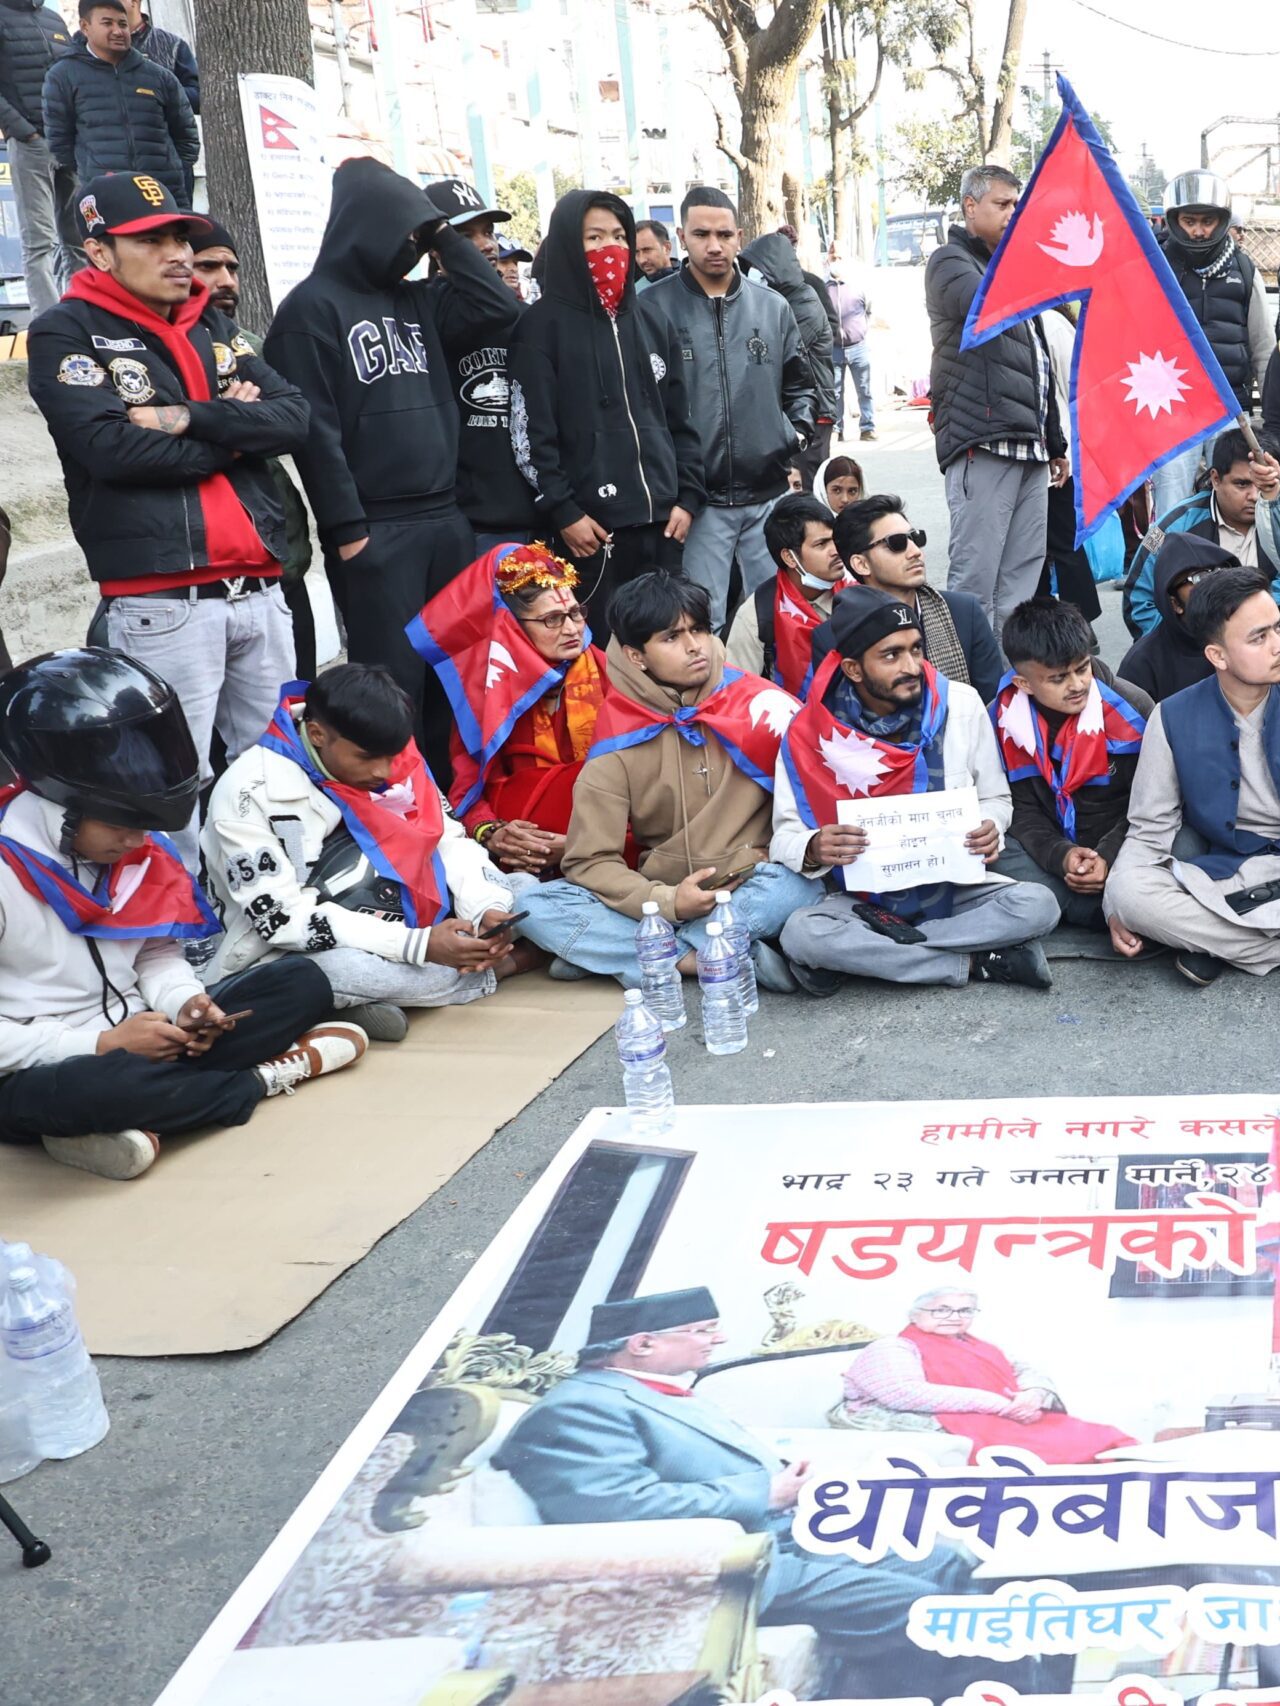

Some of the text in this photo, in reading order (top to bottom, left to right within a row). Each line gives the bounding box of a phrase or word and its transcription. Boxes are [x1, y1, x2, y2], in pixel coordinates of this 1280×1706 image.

[452, 181, 480, 206] NY
[856, 807, 964, 828] जेनजीको माग चुनाव
[899, 834, 927, 849] होइन
[881, 860, 920, 878] सुशासन
[920, 1117, 1042, 1146] हामीले
[1065, 1115, 1156, 1139] नगरे
[782, 1172, 852, 1191] भाद्र
[873, 1172, 914, 1192] २३
[936, 1165, 991, 1188] गते
[1010, 1168, 1110, 1187] जनता
[924, 1593, 1172, 1650] माईतिघर
